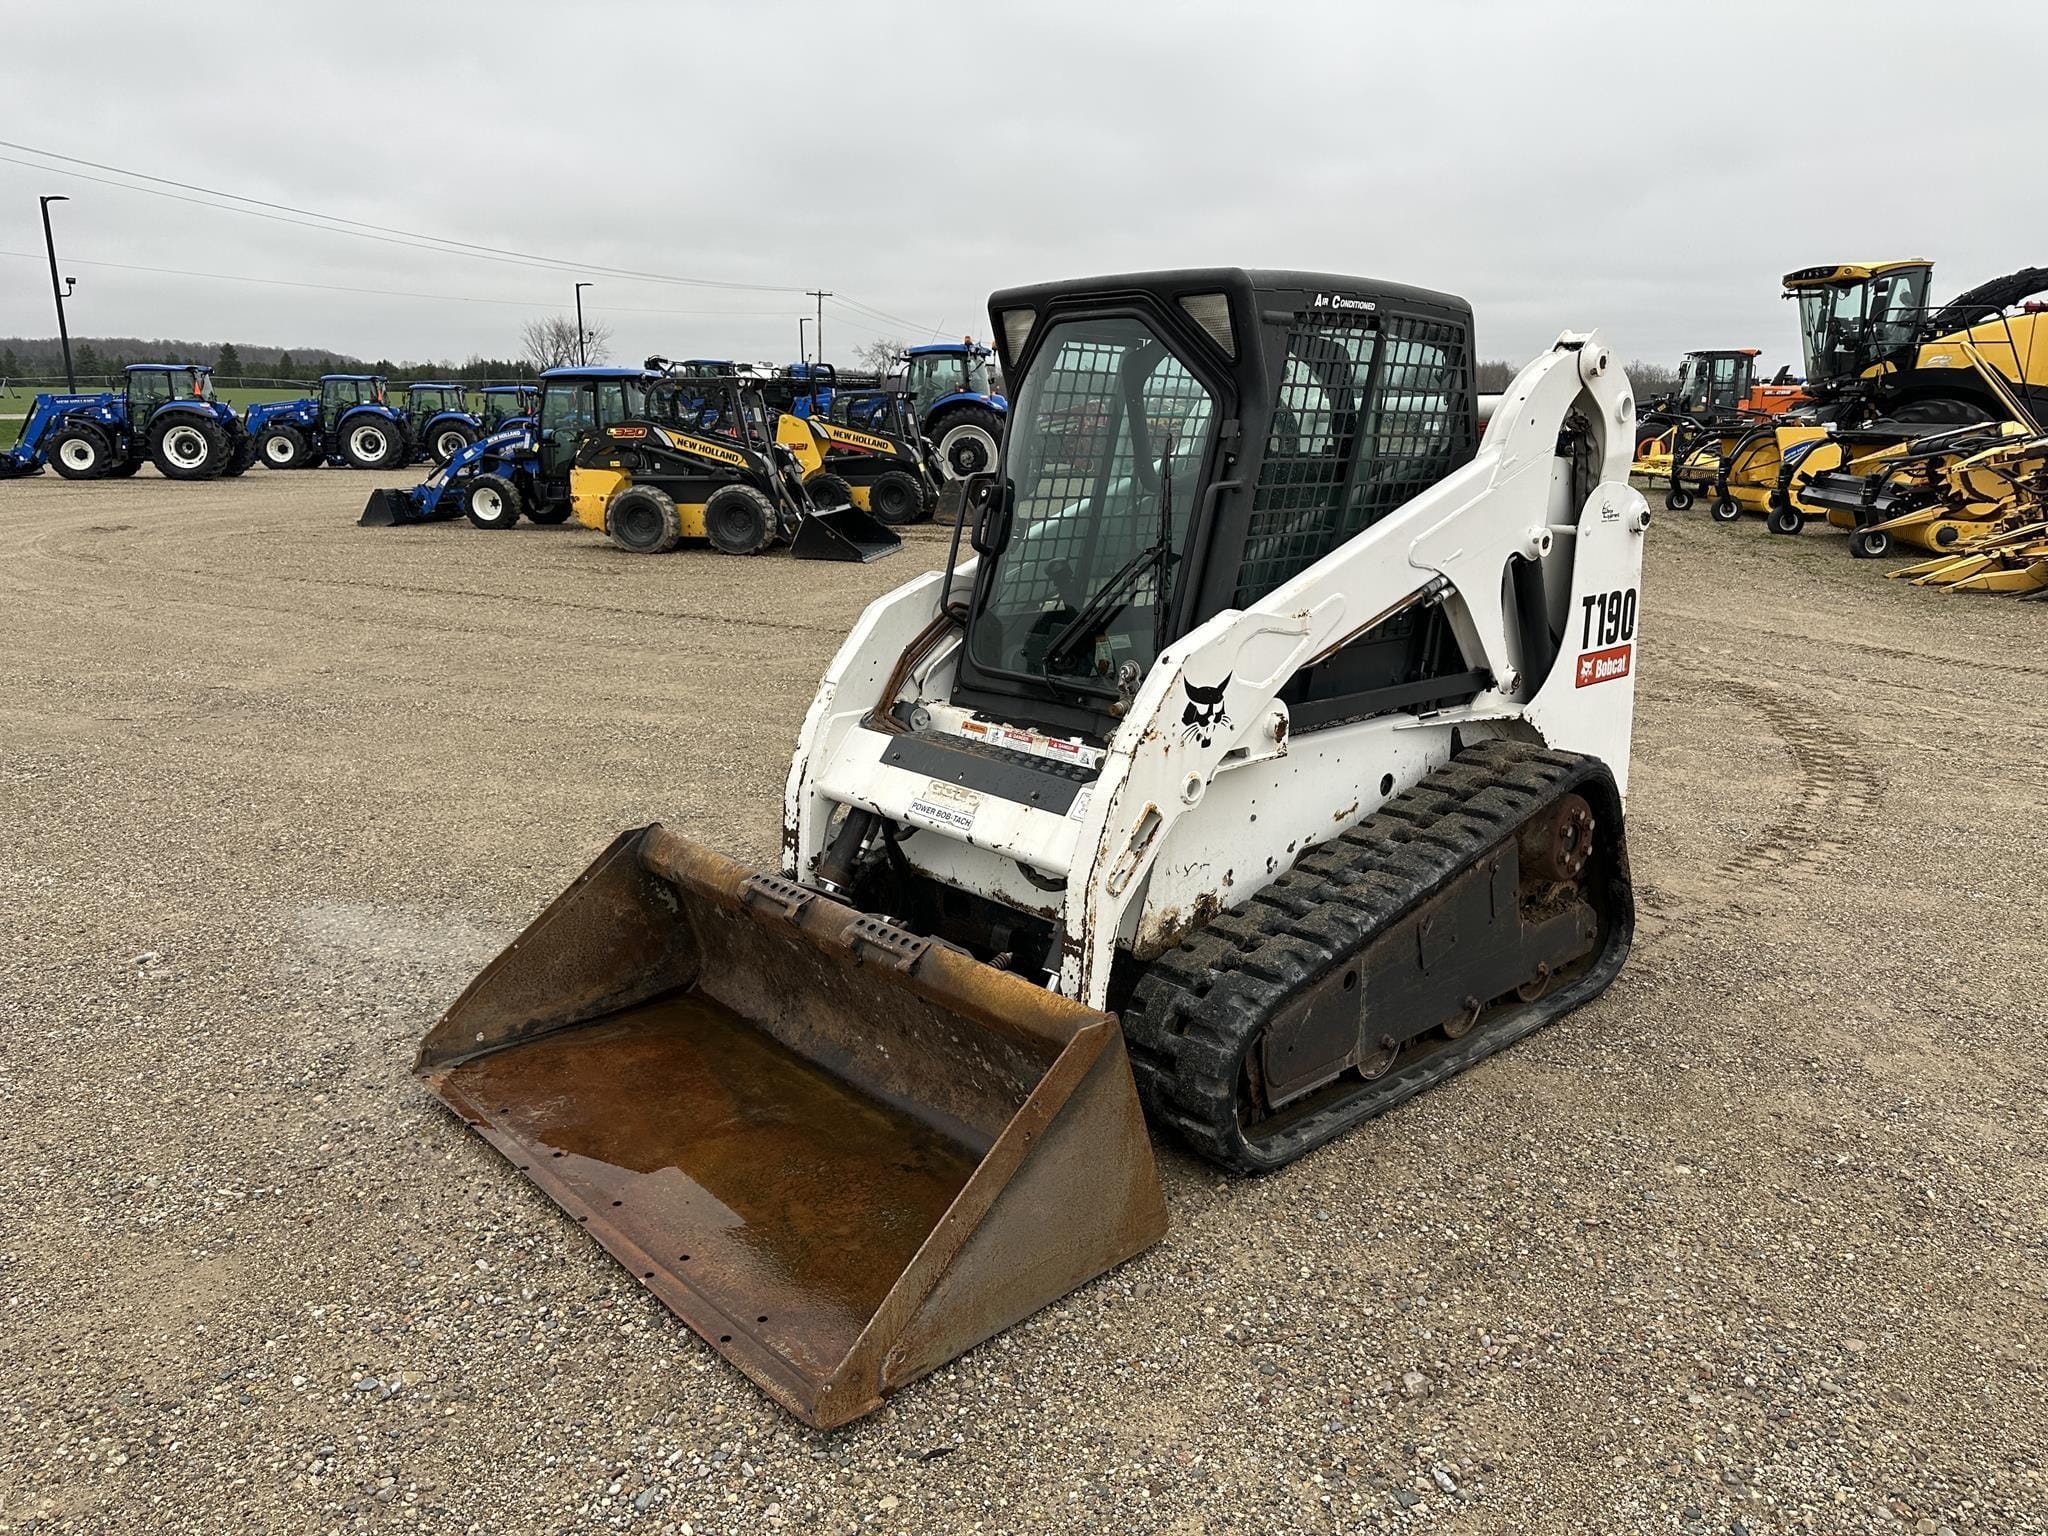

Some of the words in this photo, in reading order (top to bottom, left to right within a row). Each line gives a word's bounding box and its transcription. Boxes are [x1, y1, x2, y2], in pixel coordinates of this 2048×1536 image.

[676, 437, 698, 449] NEW
[699, 445, 739, 463] HOLLAND
[833, 429, 852, 440] NEW
[852, 434, 889, 450] HOLLAND
[1582, 588, 1637, 650] T190
[1595, 654, 1627, 678] Bobcat
[912, 802, 937, 816] POWER
[936, 808, 972, 827] BOB-TACH
